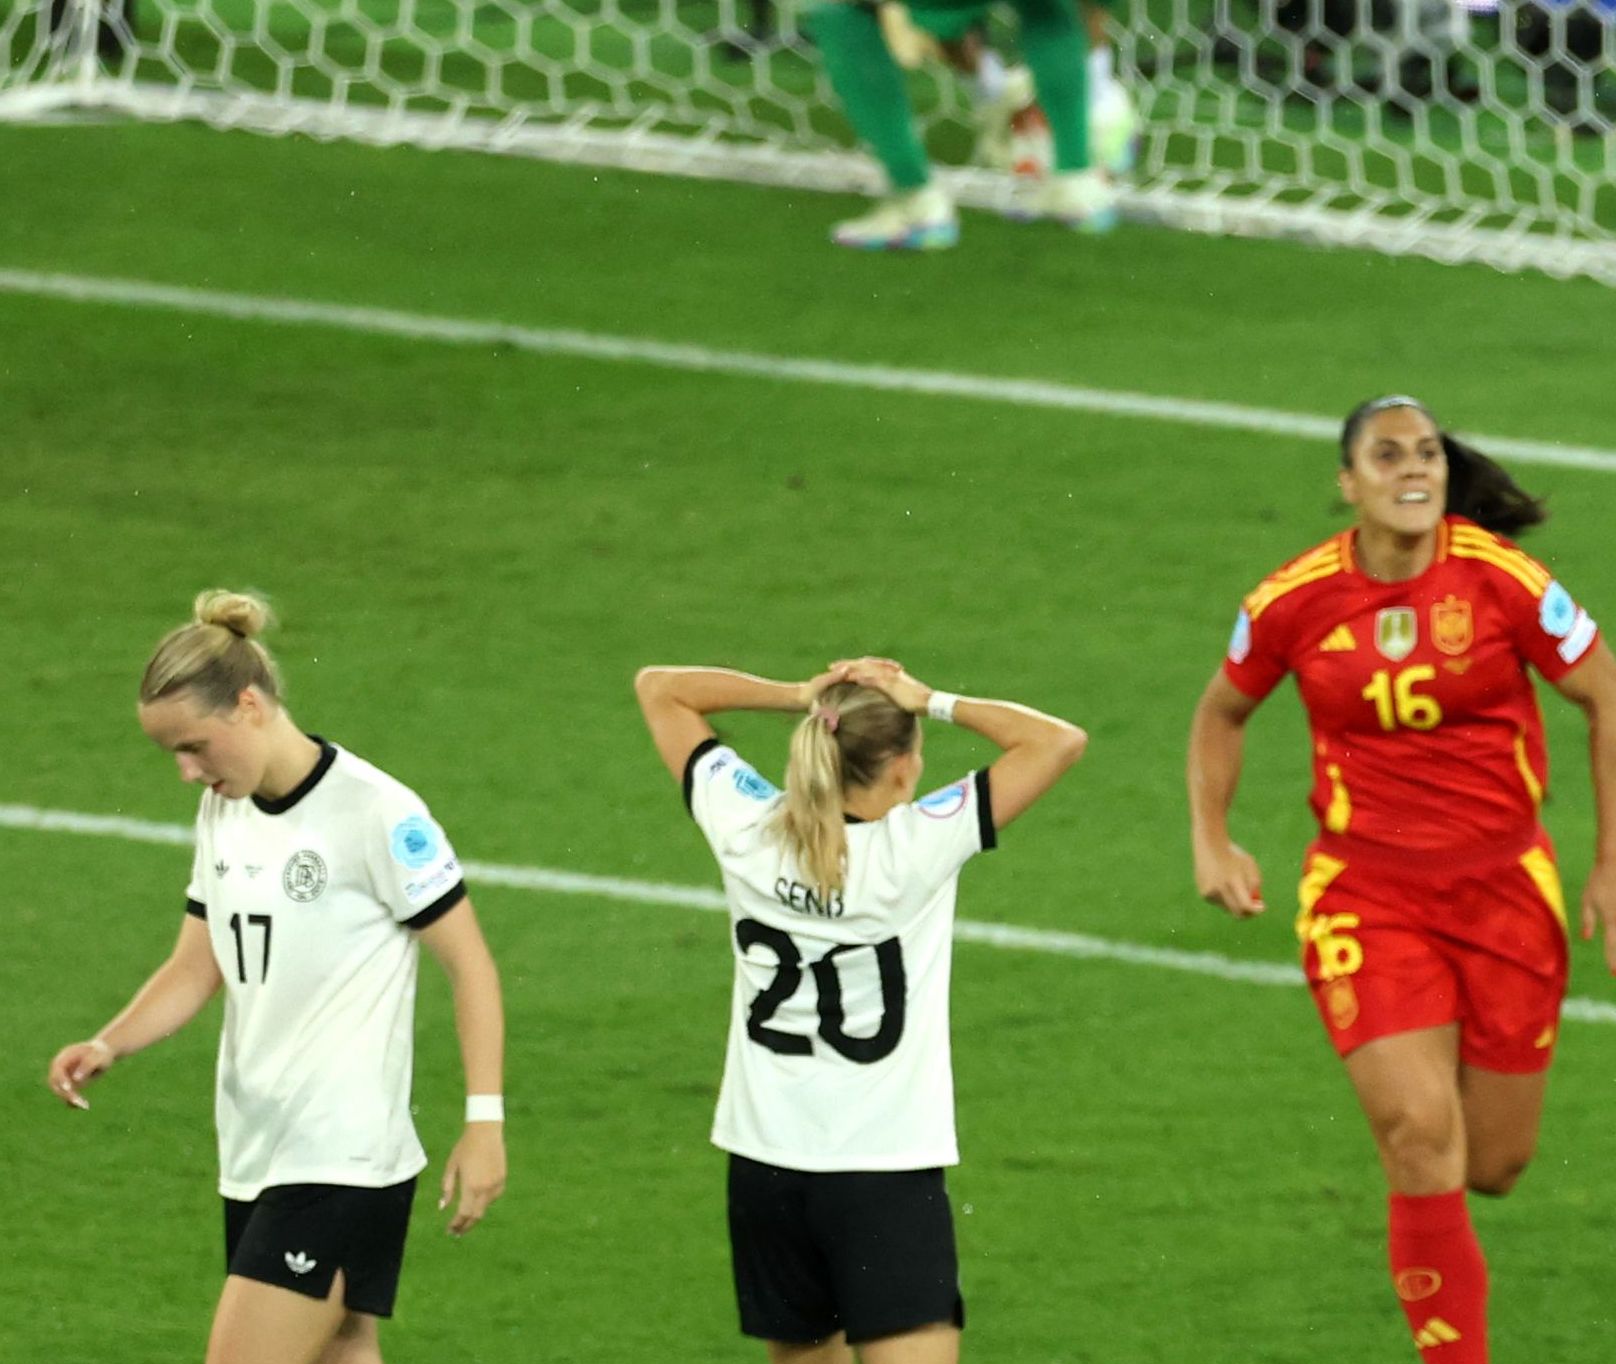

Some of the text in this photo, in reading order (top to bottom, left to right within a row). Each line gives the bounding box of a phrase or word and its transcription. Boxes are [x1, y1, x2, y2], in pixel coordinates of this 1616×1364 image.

[1362, 664, 1443, 731] 16
[230, 912, 272, 984] 17
[1308, 912, 1364, 982] 16
[735, 918, 908, 1064] 20
